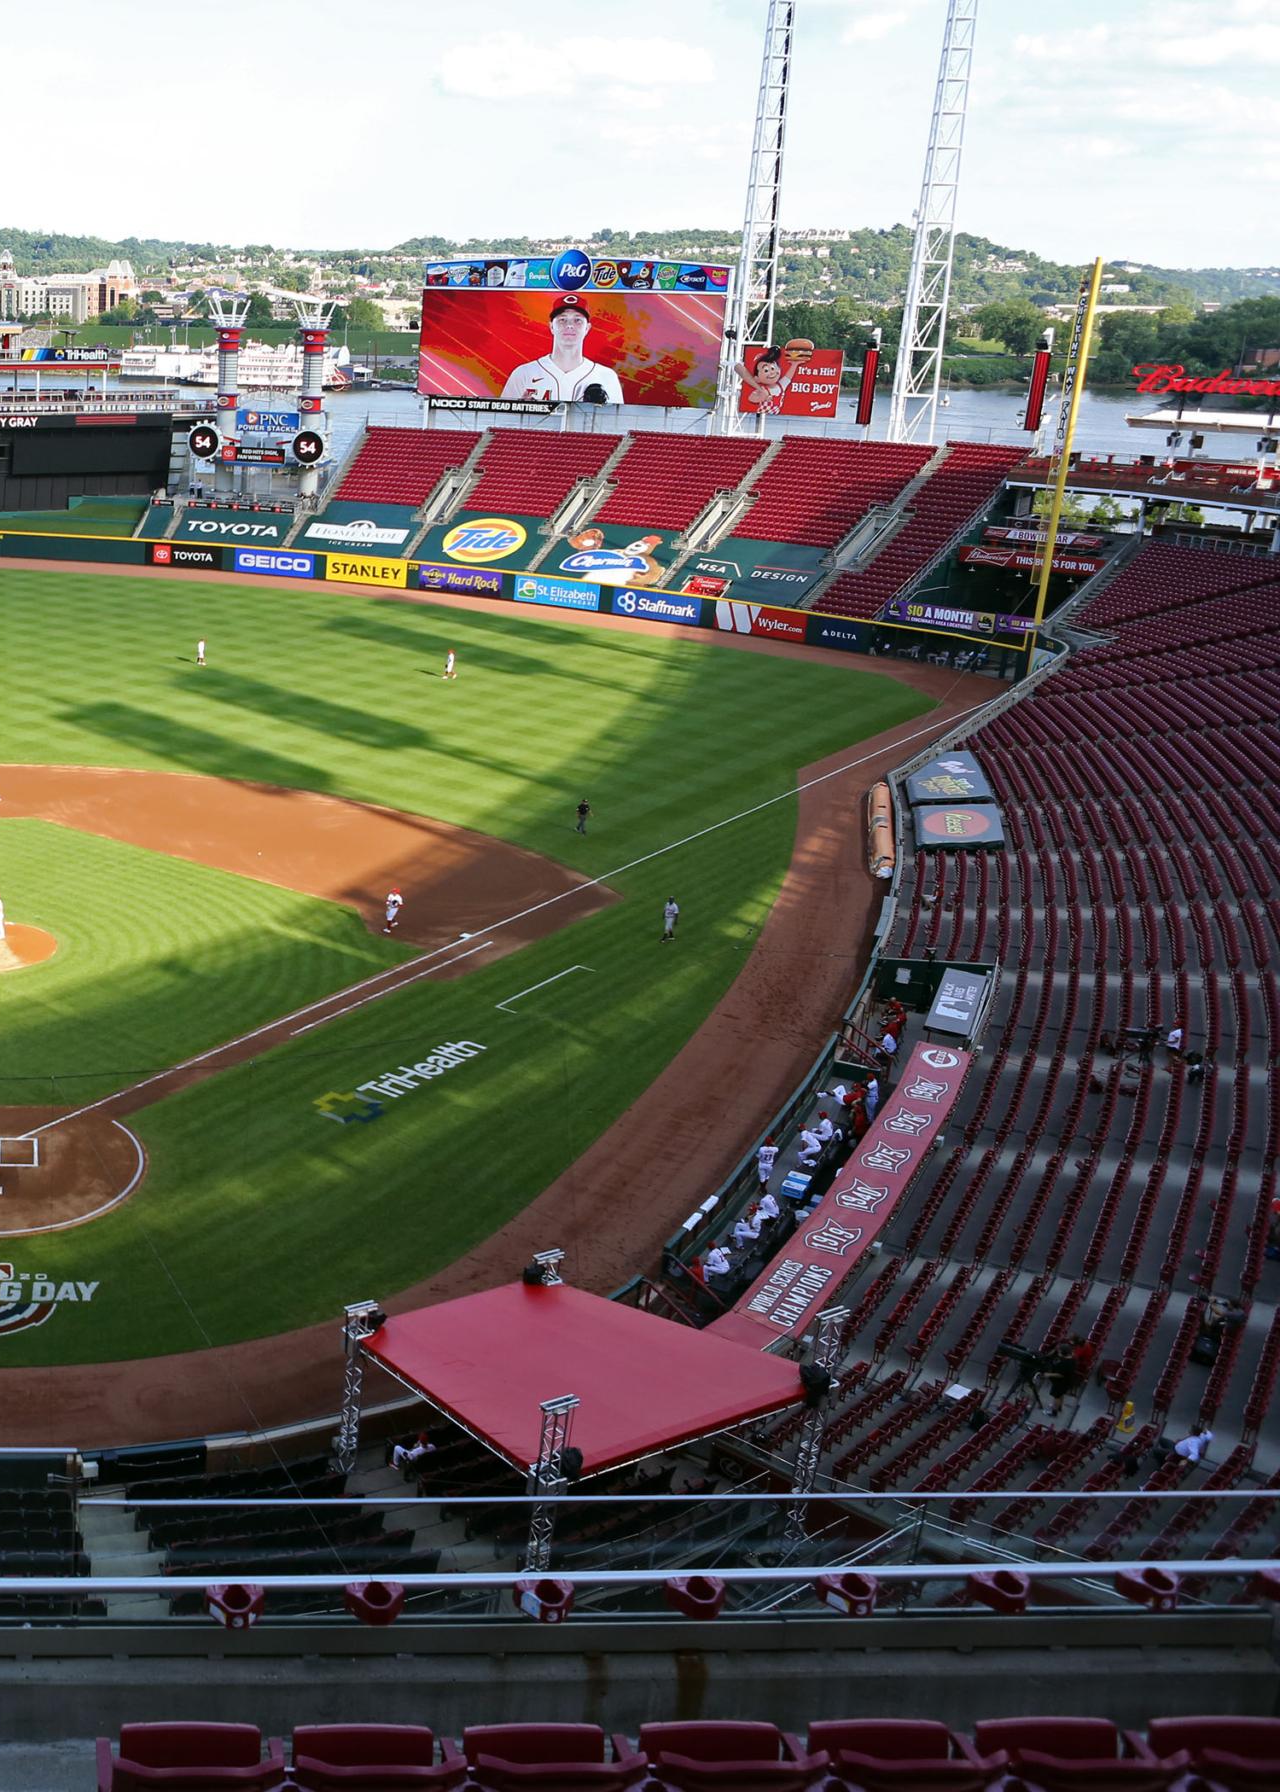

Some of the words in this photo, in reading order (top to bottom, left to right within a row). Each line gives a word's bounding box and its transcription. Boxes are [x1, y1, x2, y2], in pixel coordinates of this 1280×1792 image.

[559, 263, 588, 277] P&G
[594, 267, 616, 283] Tide
[66, 350, 108, 360] TriHealth
[798, 366, 812, 375] It's
[820, 368, 836, 376] Hit!
[791, 383, 810, 392] BIG
[812, 384, 835, 394] BOY
[431, 399, 466, 408] NOCO
[468, 401, 490, 409] START
[491, 402, 510, 410] DEAD
[10, 417, 38, 428] GRAY
[260, 414, 288, 426] PNC
[195, 436, 211, 448] 54
[299, 441, 316, 454] 54
[188, 520, 278, 537] TOYOTA
[442, 528, 520, 552] Tide
[174, 551, 213, 562] TOYOTA
[239, 554, 311, 572] GEICO
[570, 554, 635, 571] Charmin
[1016, 556, 1033, 565] THIS
[1060, 560, 1076, 570] FOR
[1078, 562, 1096, 572] YOU.
[332, 562, 400, 580] STANLEY
[696, 562, 726, 574] MSA
[751, 570, 808, 583] DESIGN
[447, 573, 473, 586] Hard
[474, 576, 498, 591] Rock
[550, 585, 596, 602] Elizabeth
[906, 604, 923, 616] $10
[925, 607, 932, 618] A
[934, 608, 973, 624] MONTH
[758, 617, 802, 634] Wyler.com
[830, 630, 857, 640] DELTA
[356, 1040, 488, 1098] TriHealth
[910, 1082, 943, 1100] 1990
[890, 1114, 926, 1134] 1976
[868, 1149, 906, 1170] 1975
[842, 1186, 882, 1212] 1940
[812, 1226, 854, 1254] 1919
[32, 1281, 100, 1302] DAY
[747, 1285, 782, 1314] WORLD
[769, 1260, 804, 1288] SERIES
[770, 1264, 832, 1326] CHAMPIONS
